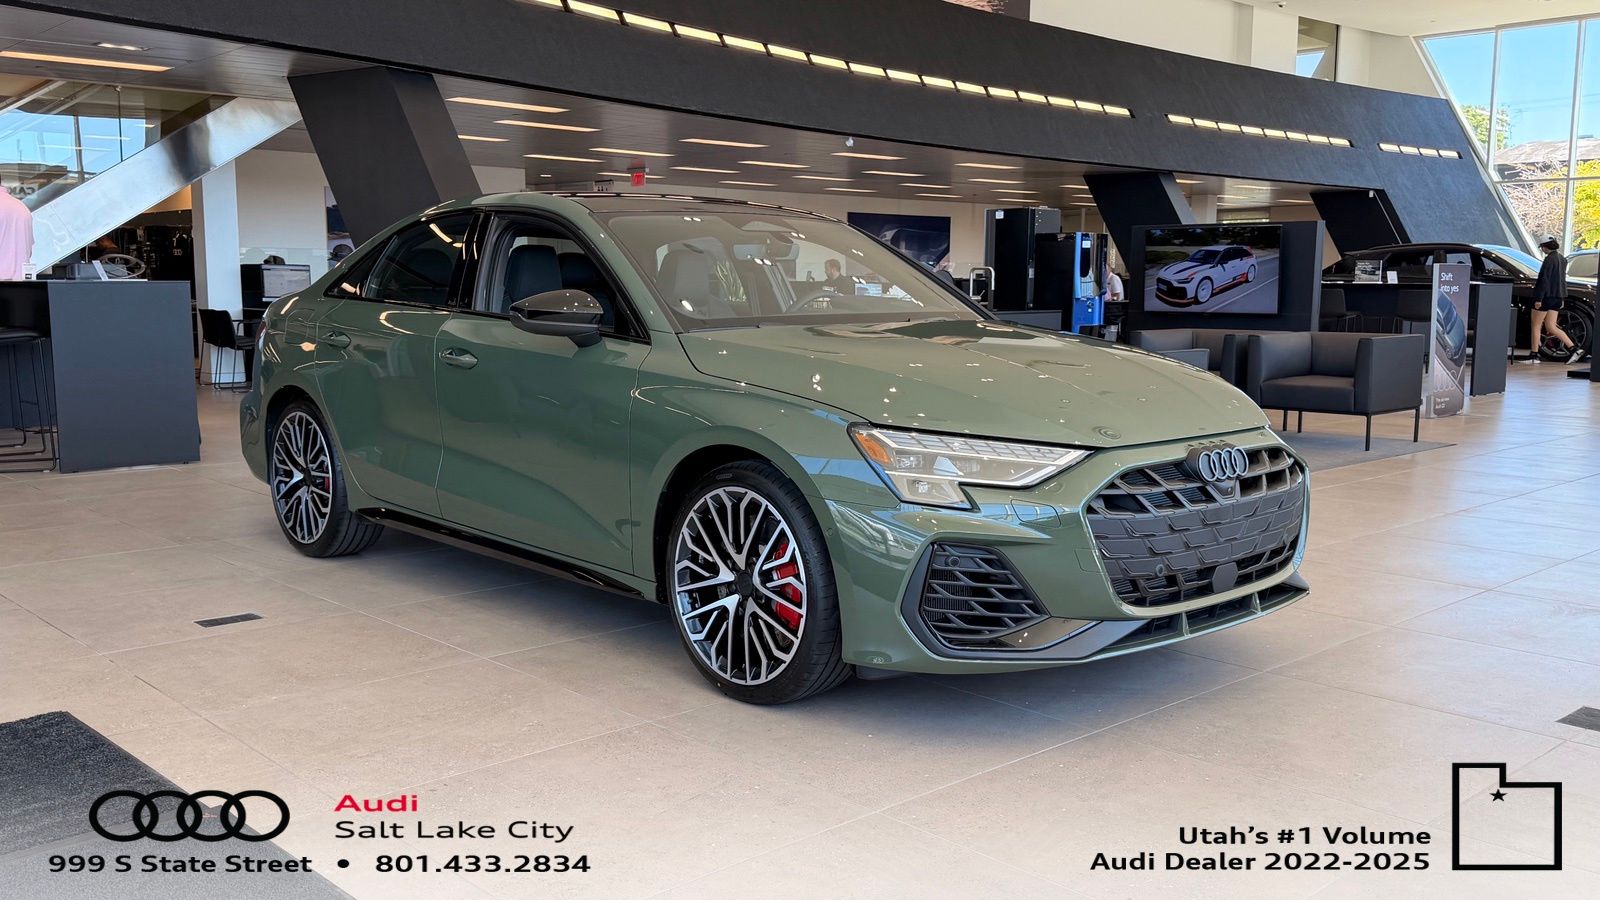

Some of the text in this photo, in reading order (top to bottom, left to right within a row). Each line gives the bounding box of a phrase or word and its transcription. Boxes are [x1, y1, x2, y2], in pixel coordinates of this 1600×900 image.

[1440, 272, 1453, 281] Shift
[1440, 283, 1460, 294] into yes
